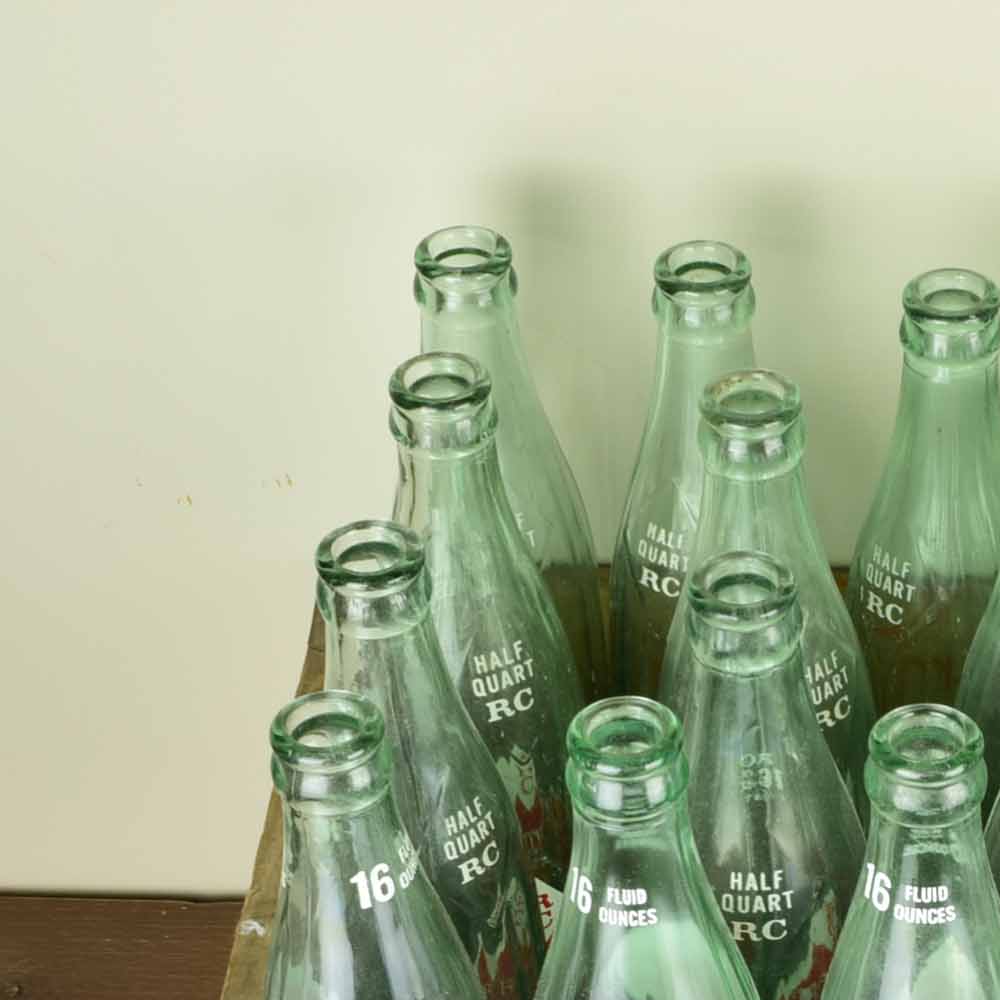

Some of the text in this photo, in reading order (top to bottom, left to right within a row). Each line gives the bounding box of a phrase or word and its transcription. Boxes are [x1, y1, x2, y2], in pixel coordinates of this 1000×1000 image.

[637, 538, 690, 573] QUART
[871, 542, 913, 578] HALF
[638, 565, 681, 598] RC
[865, 562, 917, 603] QUART
[865, 590, 905, 626] RC
[473, 639, 524, 674] HALF
[471, 658, 535, 698] QUART
[811, 665, 849, 705] UART
[485, 687, 535, 723] RC
[445, 796, 484, 837] HALF
[443, 811, 496, 861] QUART
[456, 840, 500, 885] RC
[730, 869, 784, 892] HALF
[350, 862, 396, 910] 16
[571, 867, 648, 914] 16 FLUID
[721, 890, 795, 914] QUART
[863, 862, 949, 912] 16 FLUID
[598, 907, 658, 928] OUNCES
[730, 919, 788, 942] RC
[894, 904, 956, 925] OUNCES
